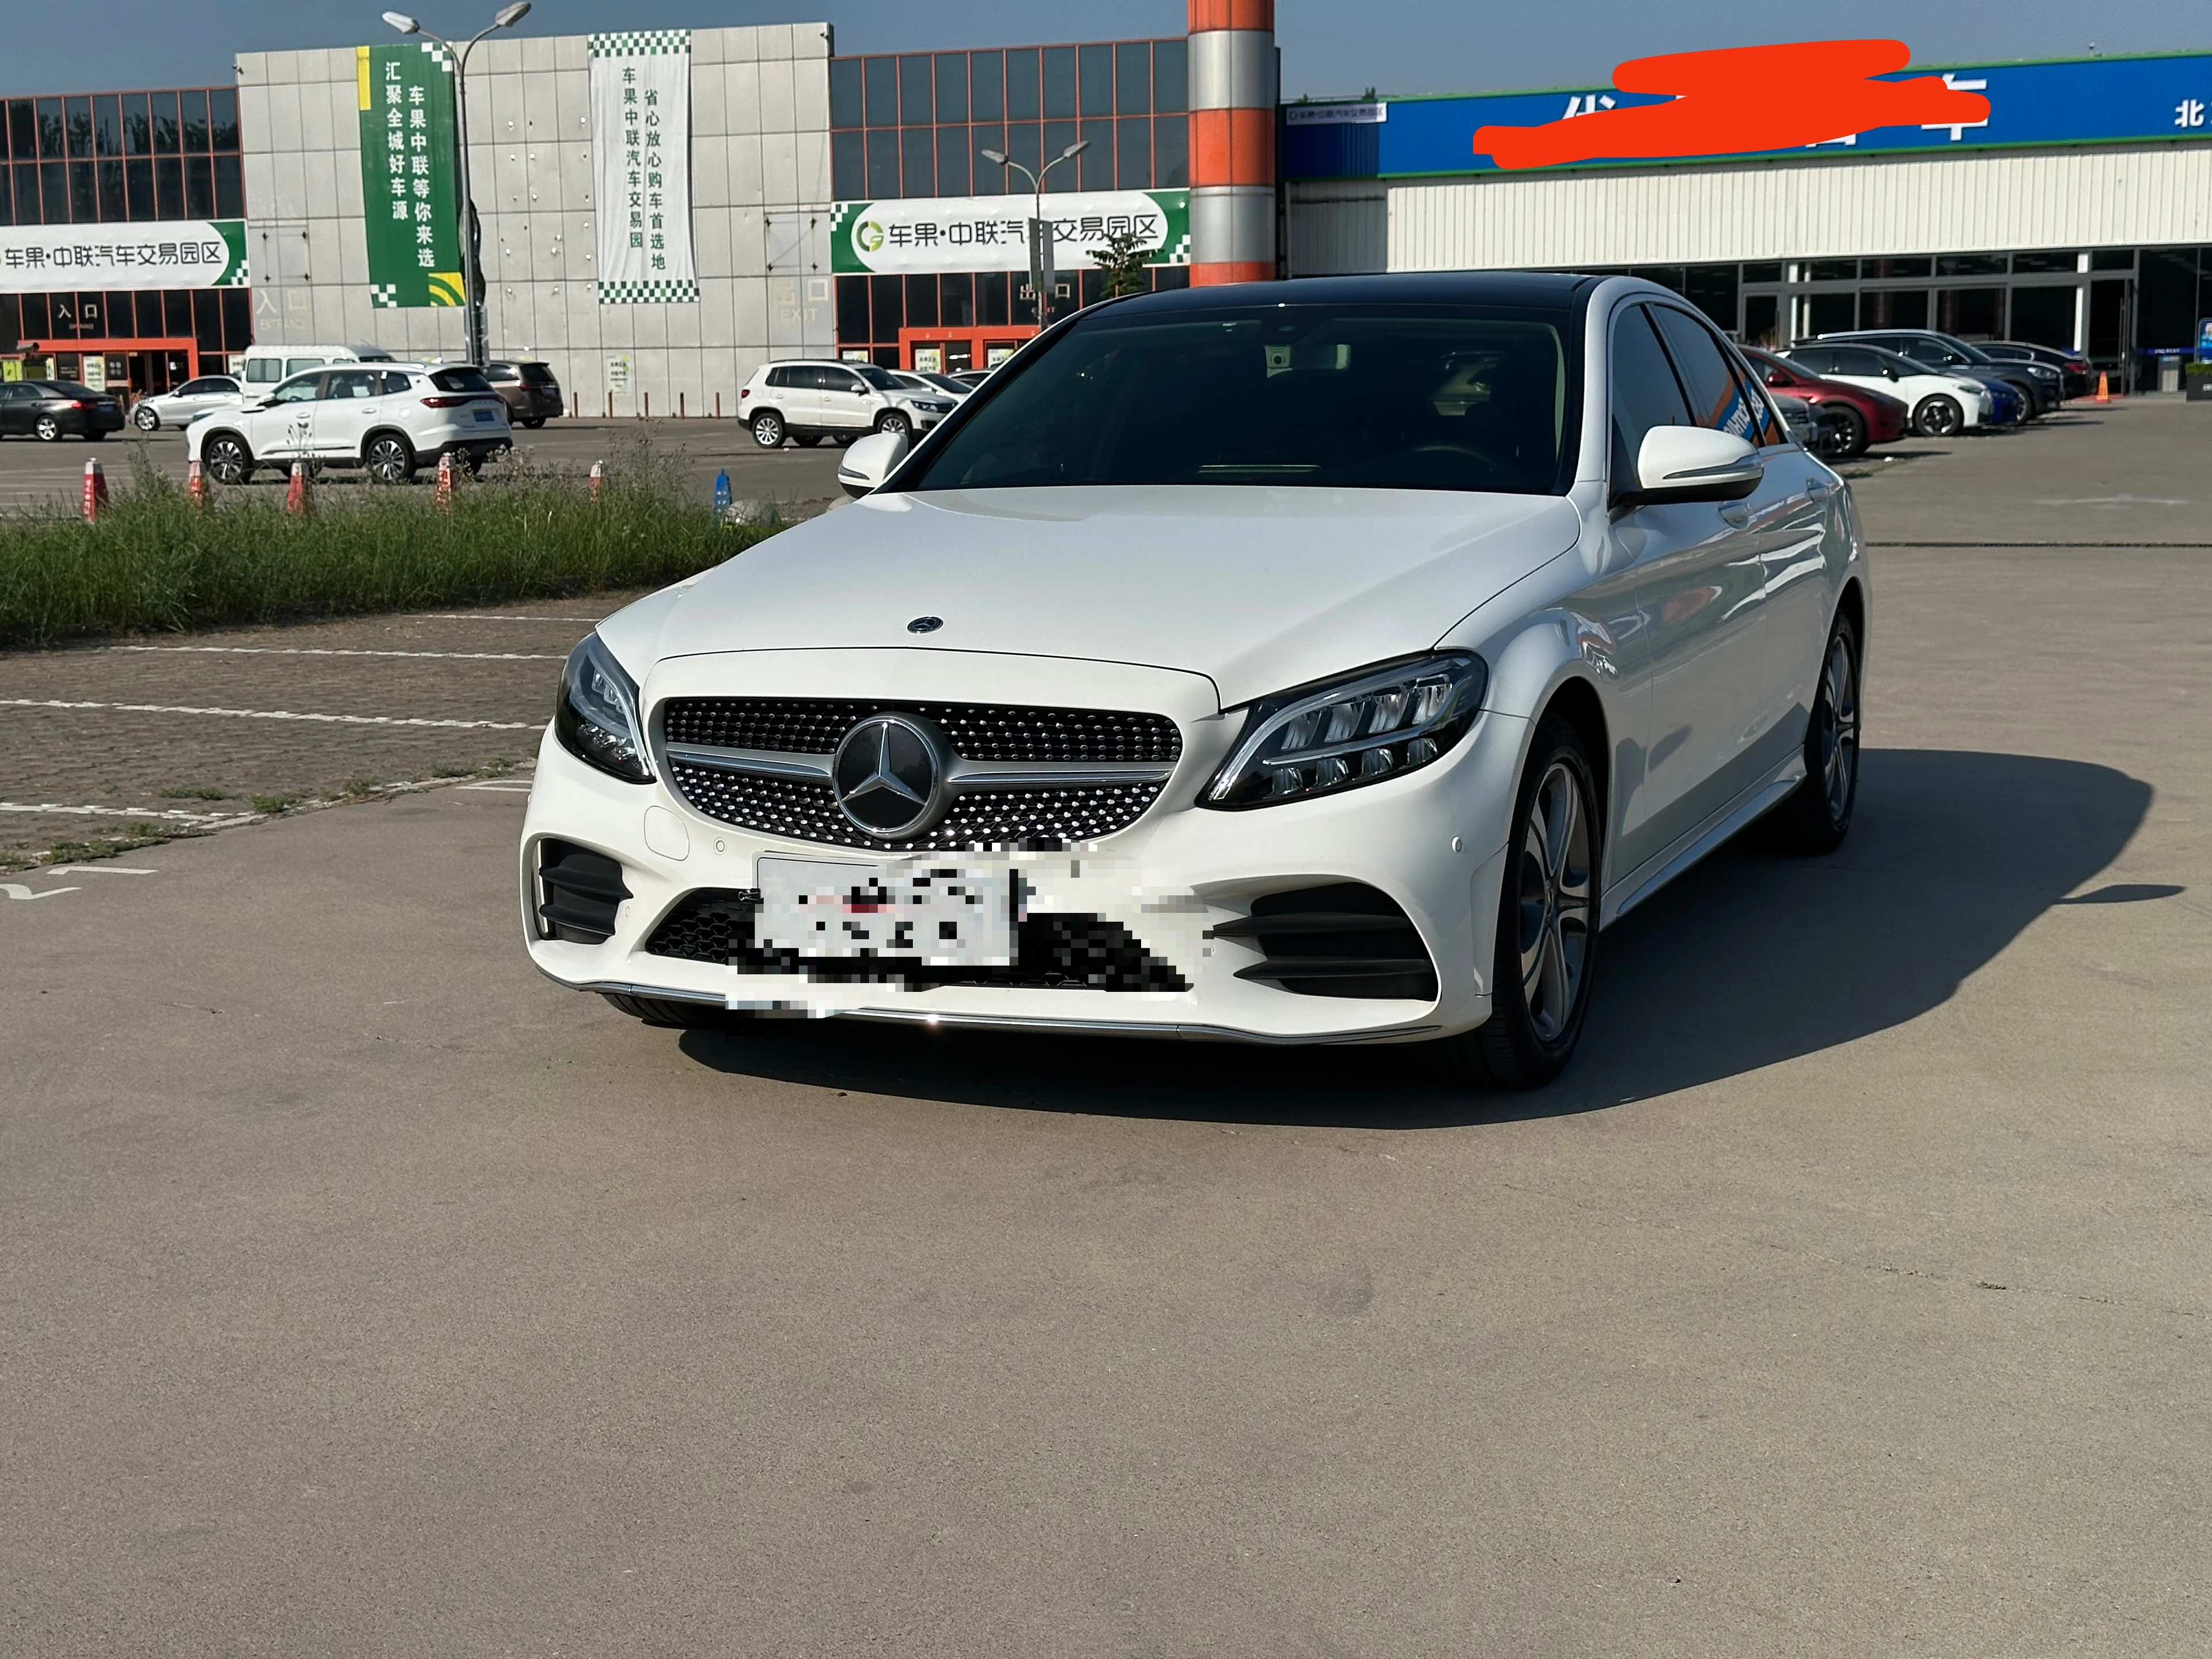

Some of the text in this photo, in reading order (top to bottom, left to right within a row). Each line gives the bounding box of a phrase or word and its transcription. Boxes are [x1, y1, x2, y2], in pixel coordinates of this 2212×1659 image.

[2174, 99, 2212, 127] 北
[385, 62, 408, 220] 汇聚全城好车源
[622, 67, 643, 248] 车果中联汽车交易园
[408, 86, 435, 267] 车果中联等你来选
[645, 89, 666, 271] 省心放心购车首选地
[888, 214, 1158, 248] 车果·中联汽交易园区
[58, 304, 97, 319] 入口
[256, 290, 306, 315] 入口
[780, 308, 817, 322] EXIT
